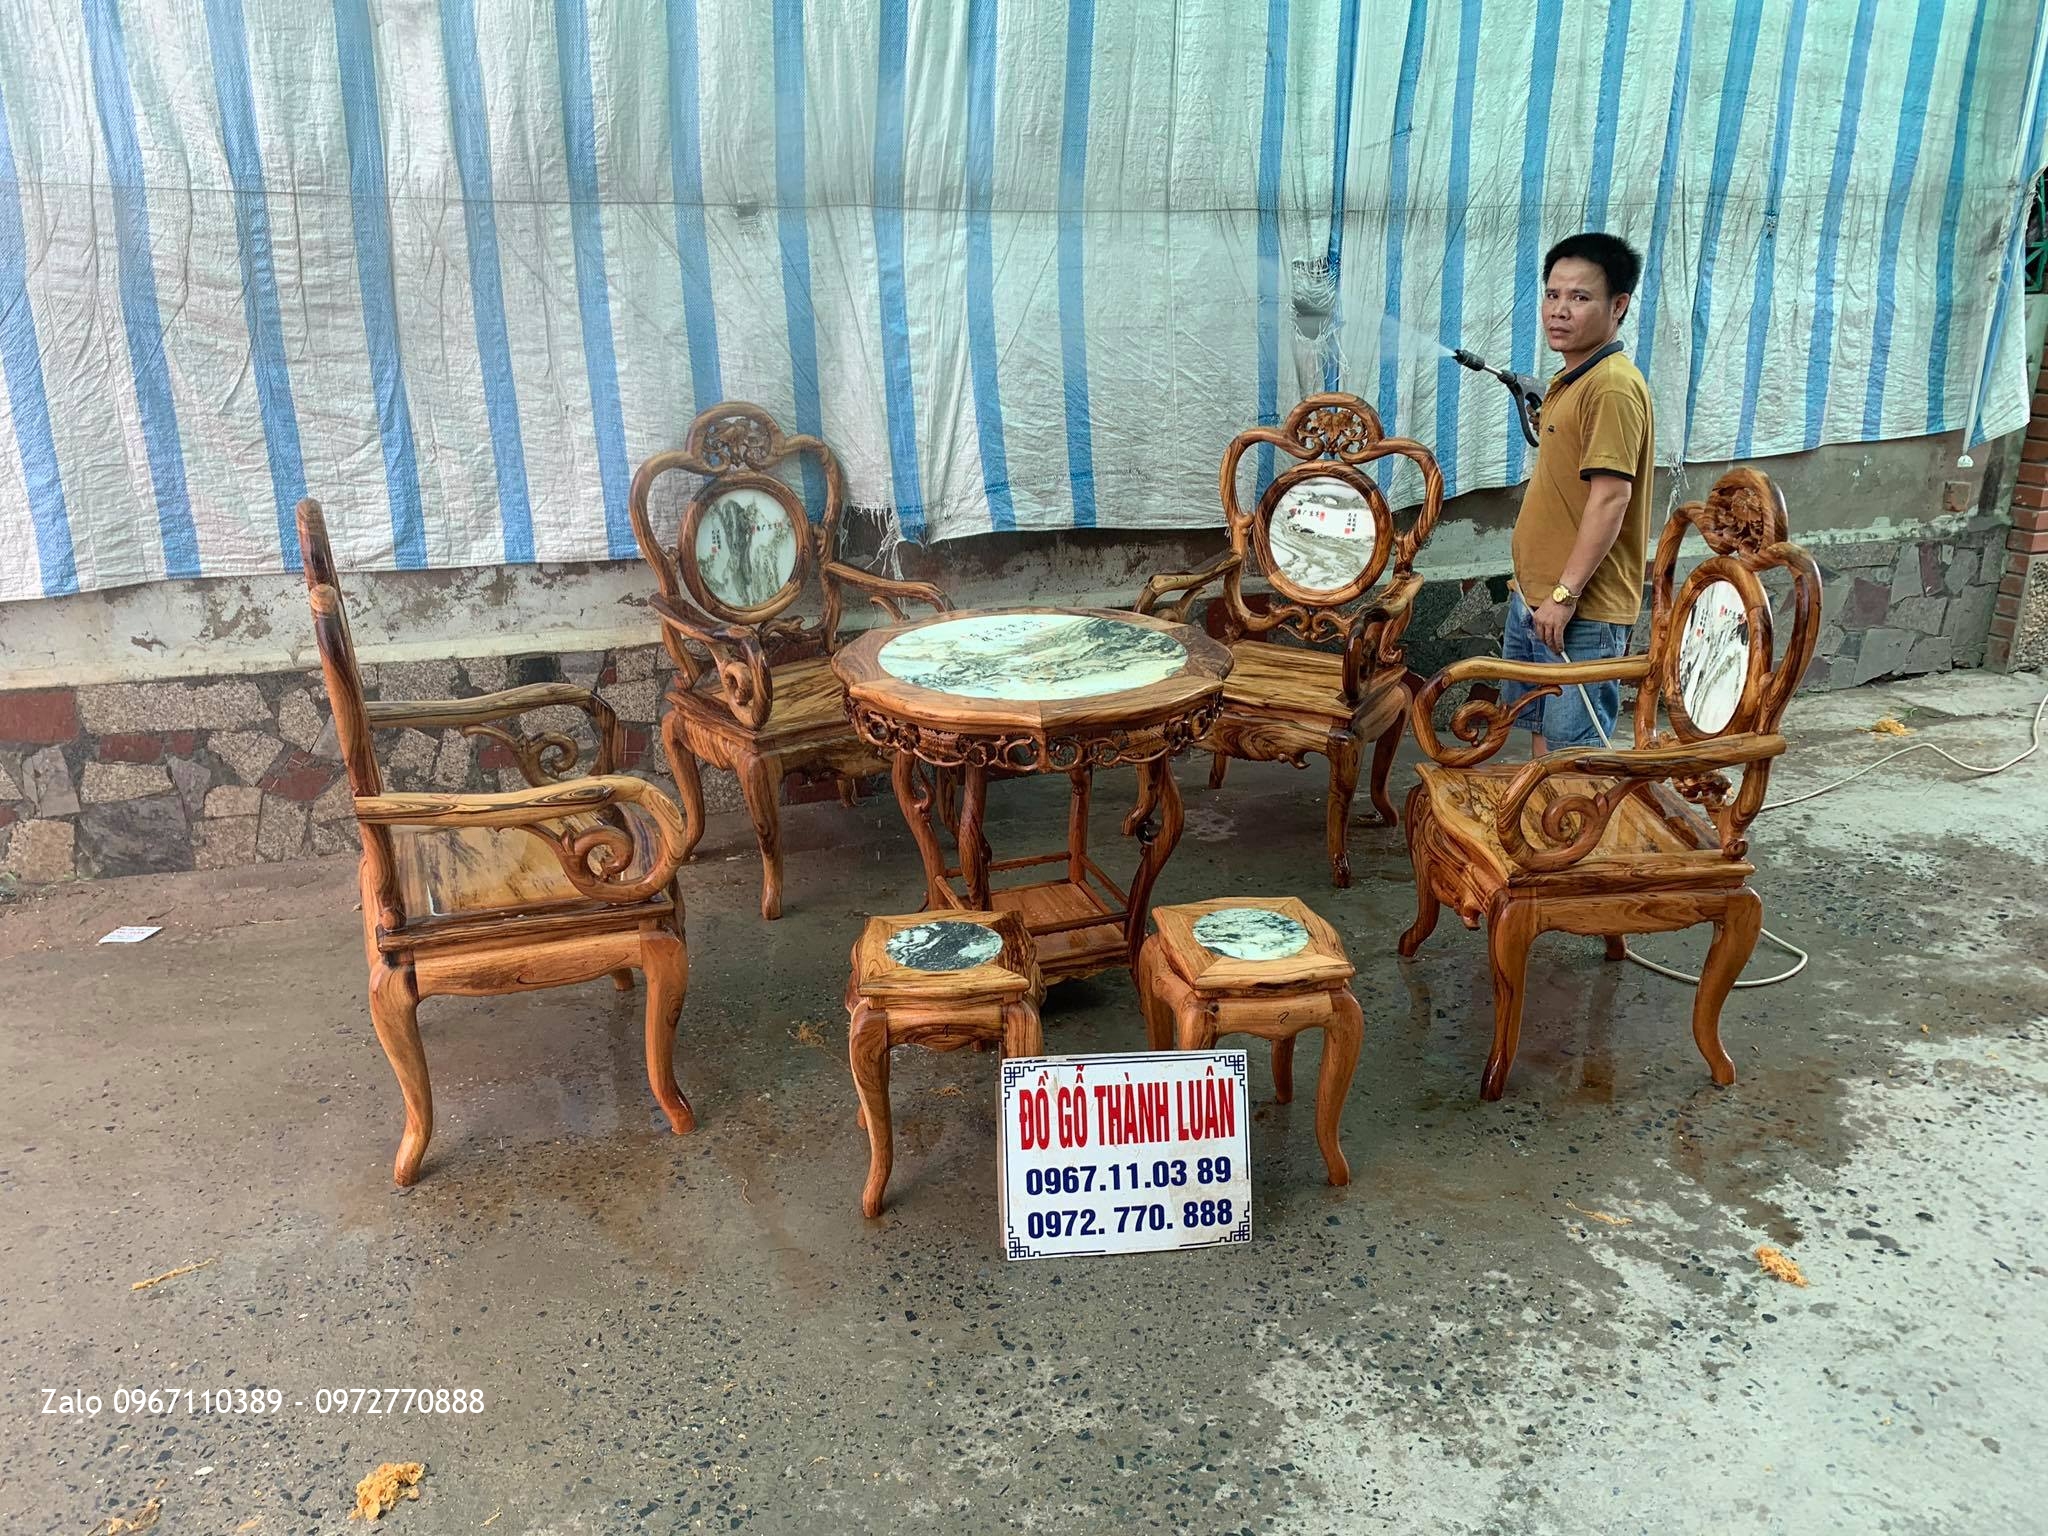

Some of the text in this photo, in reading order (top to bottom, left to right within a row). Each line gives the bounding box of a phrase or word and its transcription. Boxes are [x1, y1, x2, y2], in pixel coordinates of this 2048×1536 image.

[1019, 1065, 1236, 1150] ĐỒ GỖ THÀNH LUÂN
[1183, 1199, 1232, 1228] 888
